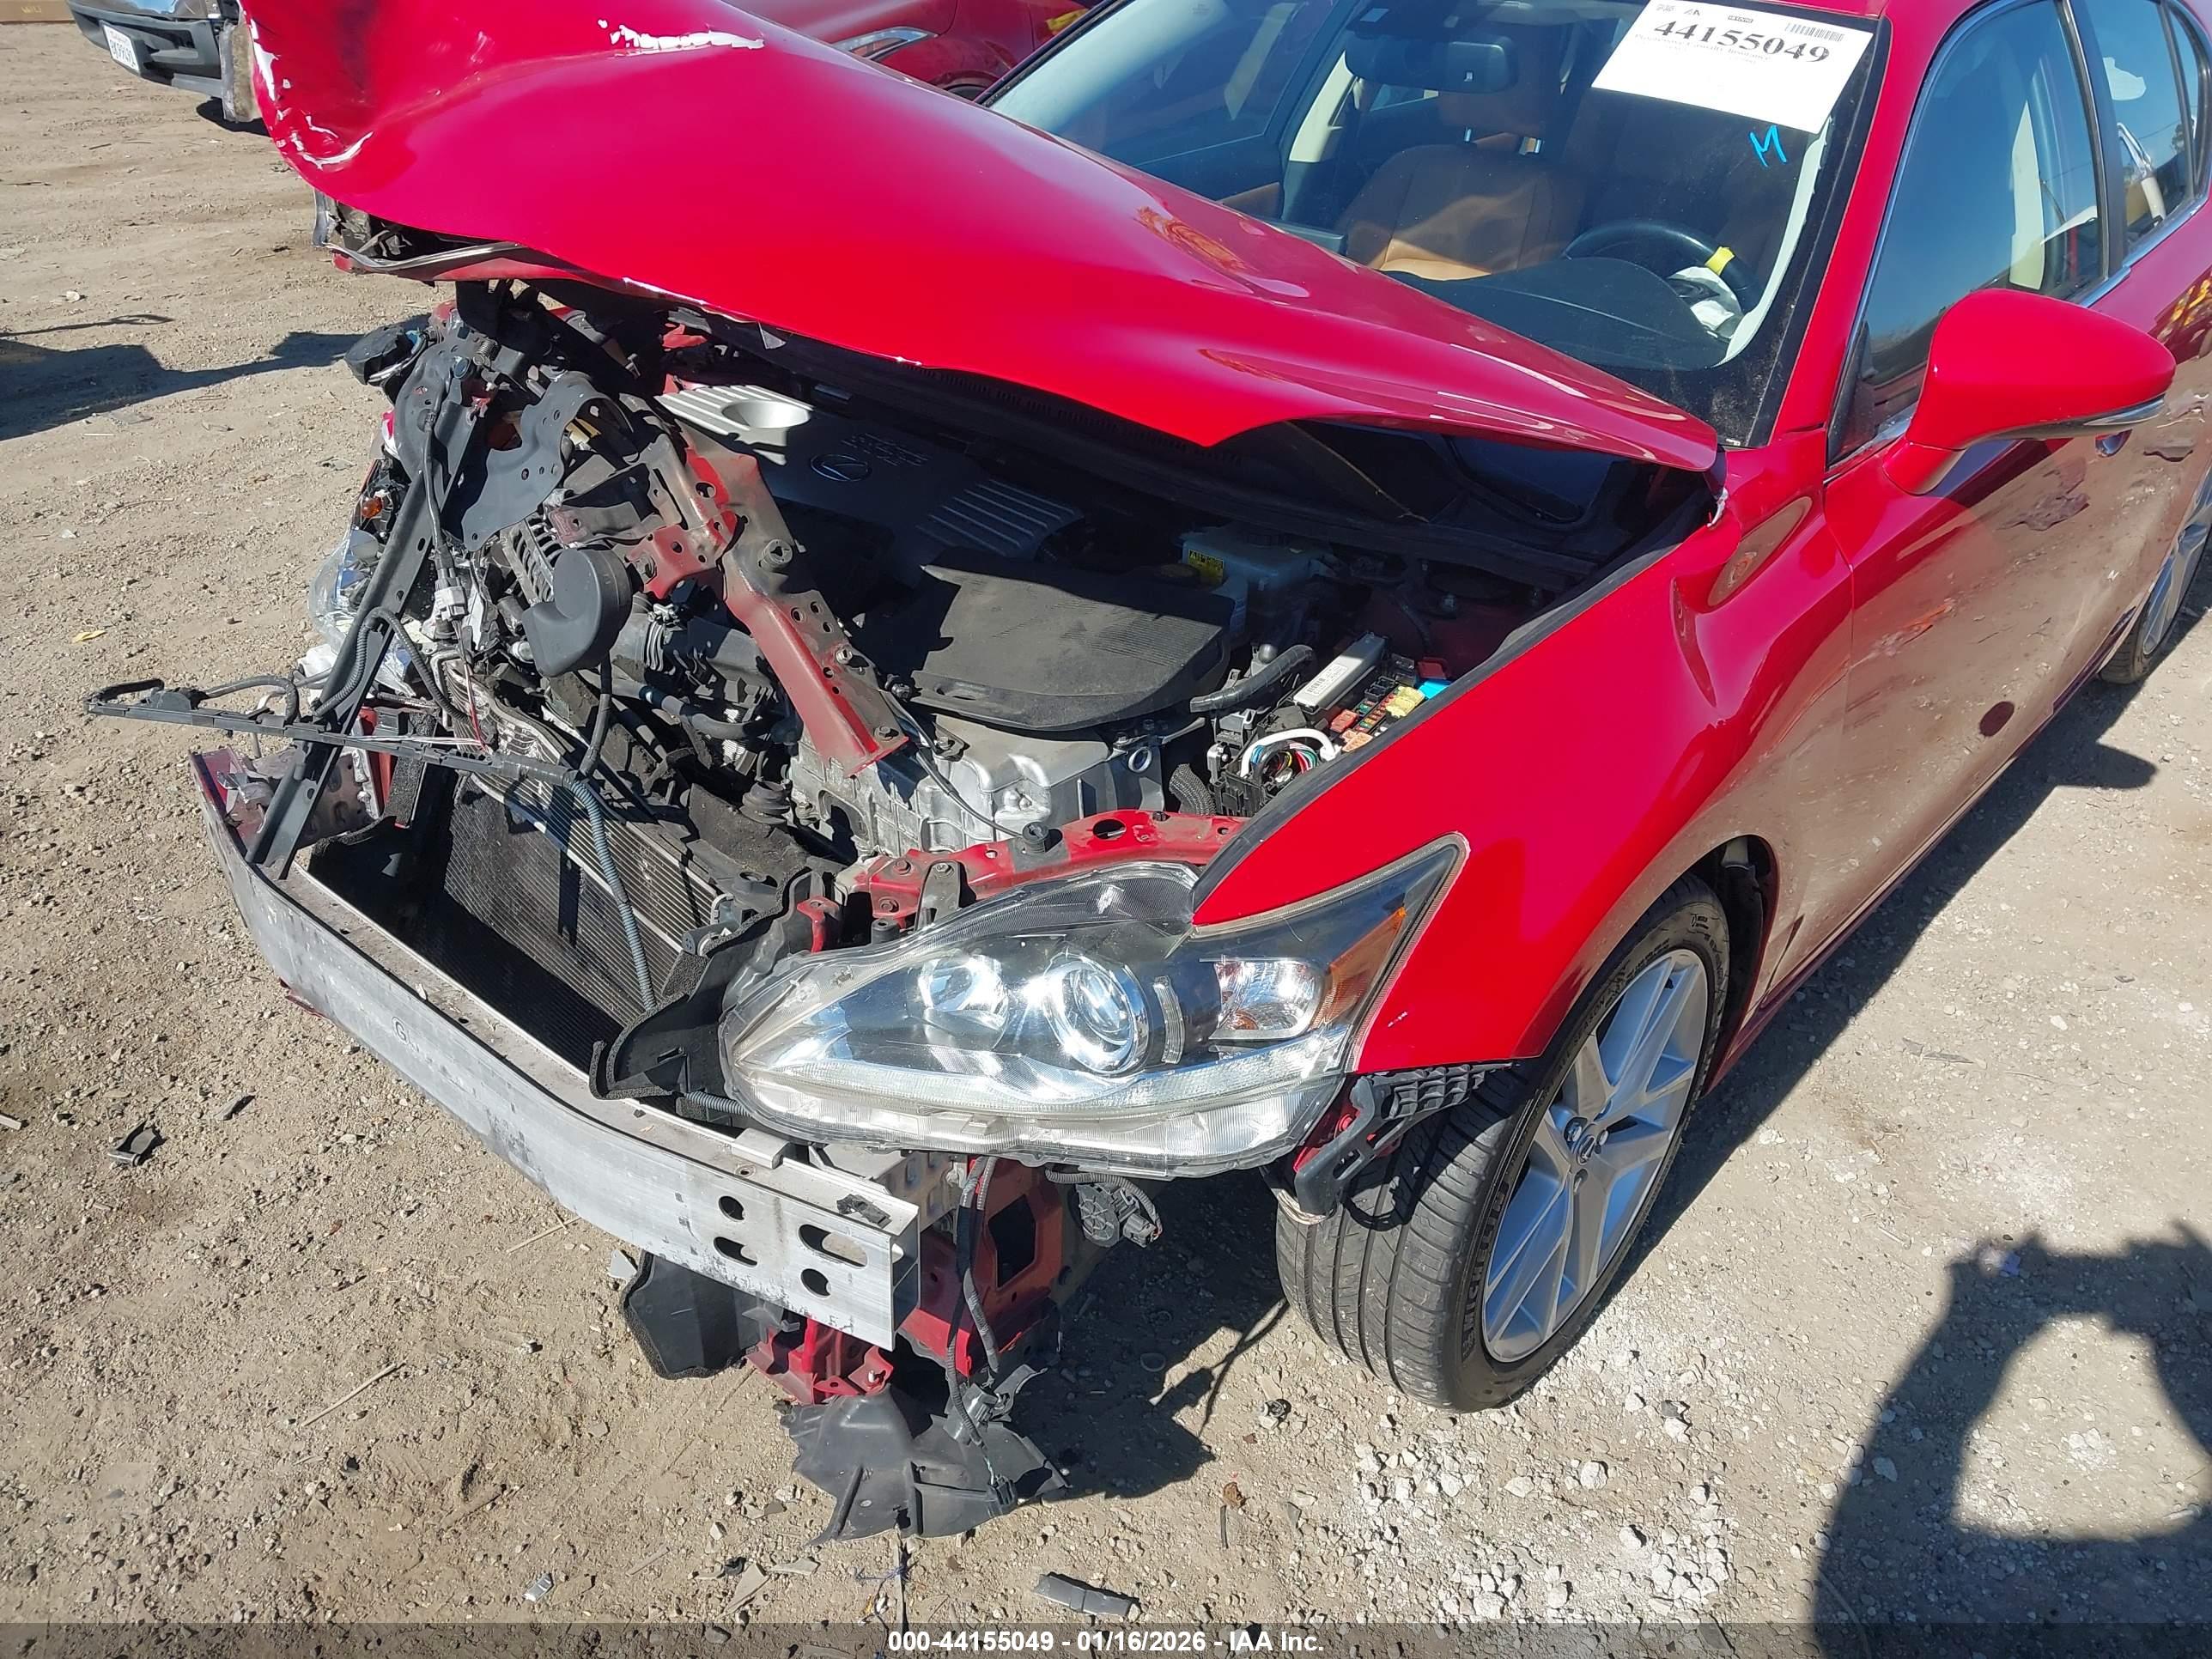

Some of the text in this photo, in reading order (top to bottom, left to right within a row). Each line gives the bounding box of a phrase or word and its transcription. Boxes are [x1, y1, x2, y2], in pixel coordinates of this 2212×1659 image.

[1654, 21, 1830, 63] 44155049
[1748, 124, 1787, 167] M
[1462, 1190, 1508, 1331] MICHELIN
